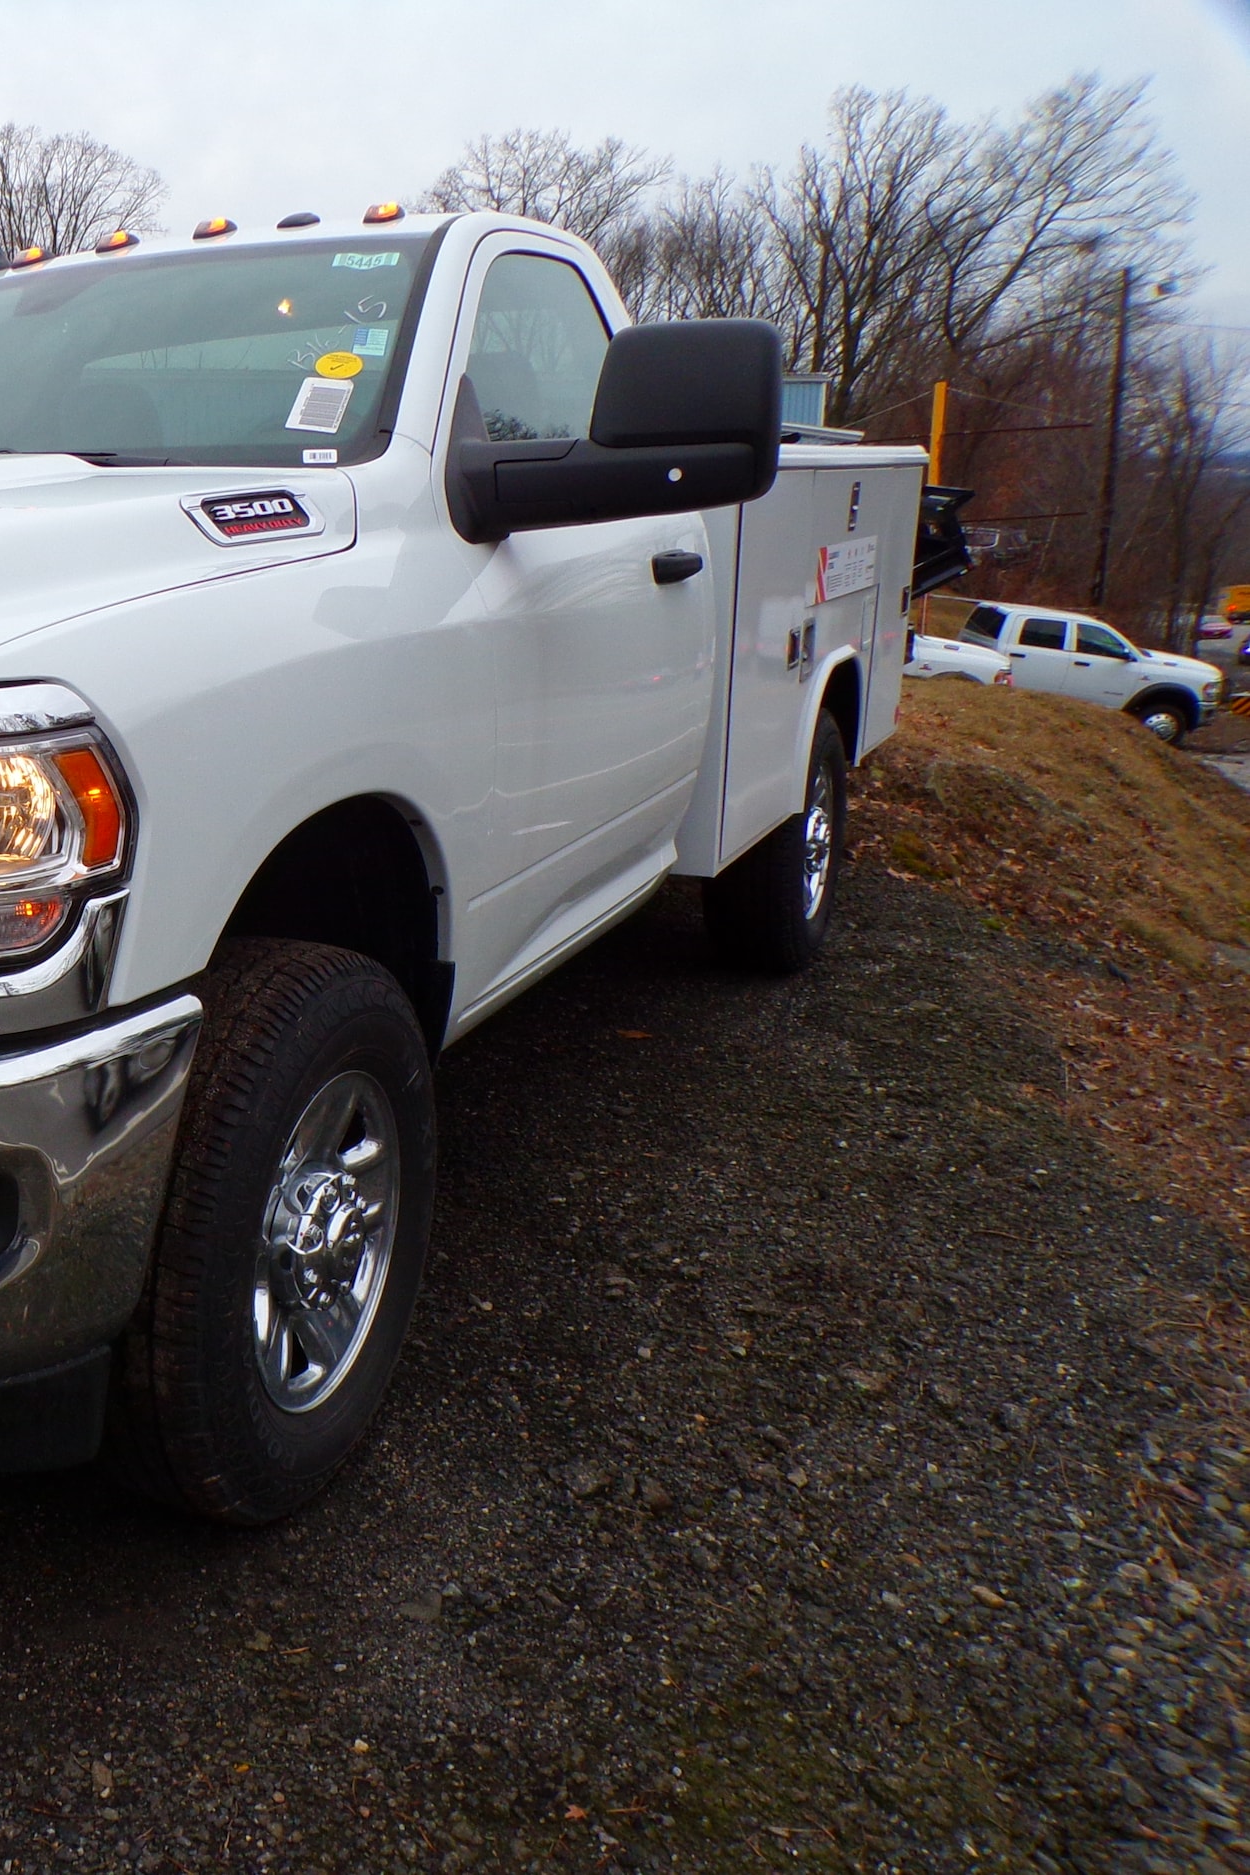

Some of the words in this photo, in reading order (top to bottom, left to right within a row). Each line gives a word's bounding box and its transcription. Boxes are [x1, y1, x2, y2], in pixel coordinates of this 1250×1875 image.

[345, 255, 383, 268] 5445
[211, 498, 294, 521] 3500
[224, 520, 267, 535] HEAVY
[269, 516, 304, 530] DUTY
